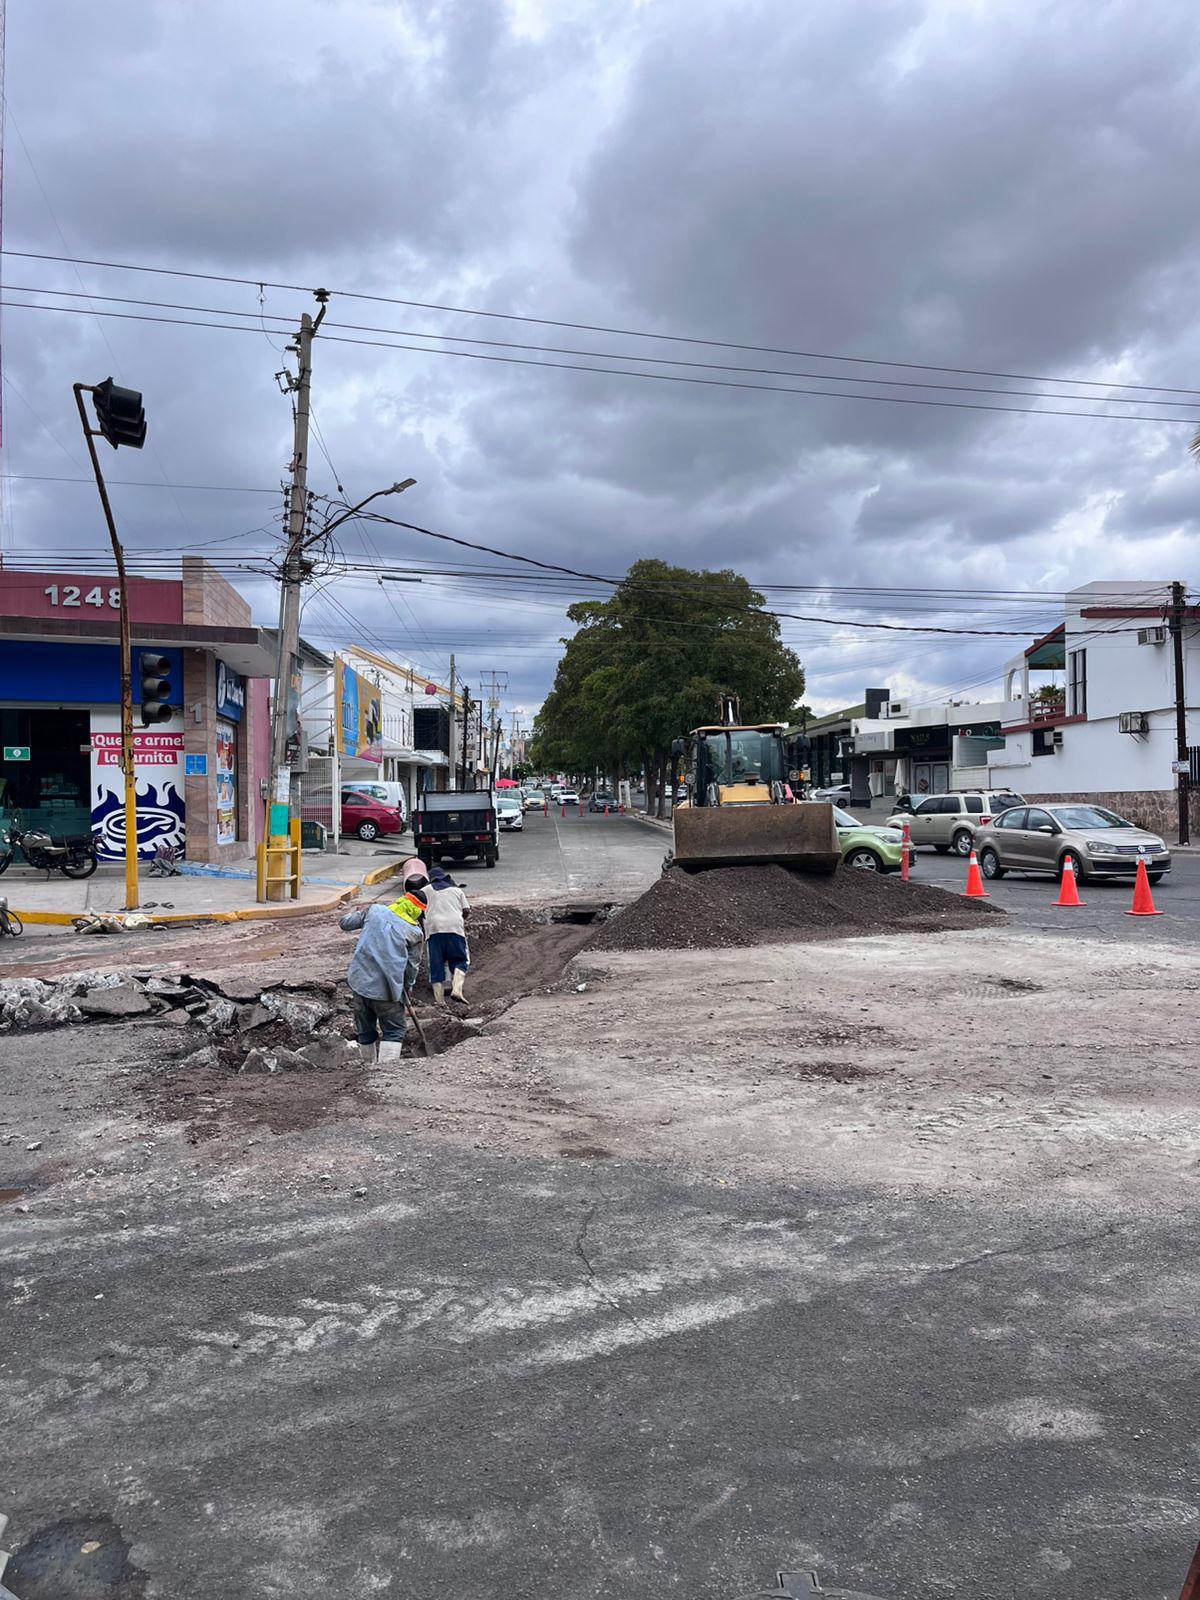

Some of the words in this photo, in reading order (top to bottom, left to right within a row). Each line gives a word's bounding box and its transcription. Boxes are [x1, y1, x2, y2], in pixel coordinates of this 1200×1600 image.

[44, 584, 121, 609] 1248
[189, 703, 202, 722] 1
[91, 734, 122, 747] ¡Que
[144, 735, 184, 746] arme!
[104, 751, 119, 763] la
[133, 751, 173, 763] rnita
